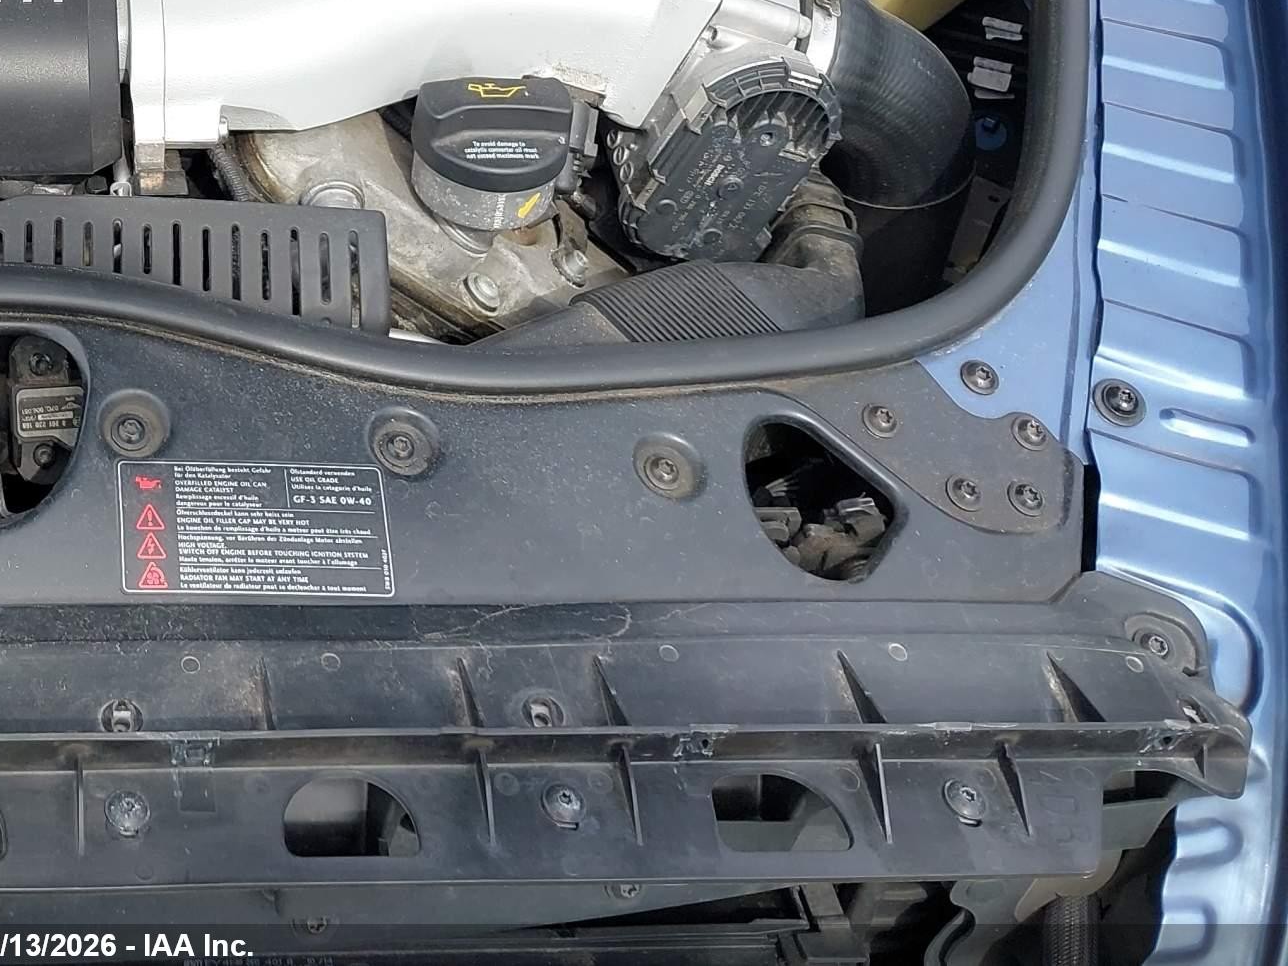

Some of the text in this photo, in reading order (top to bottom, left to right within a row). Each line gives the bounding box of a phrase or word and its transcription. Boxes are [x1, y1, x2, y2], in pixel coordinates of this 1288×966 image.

[293, 495, 371, 505] GF-3 SAE 0W-40
